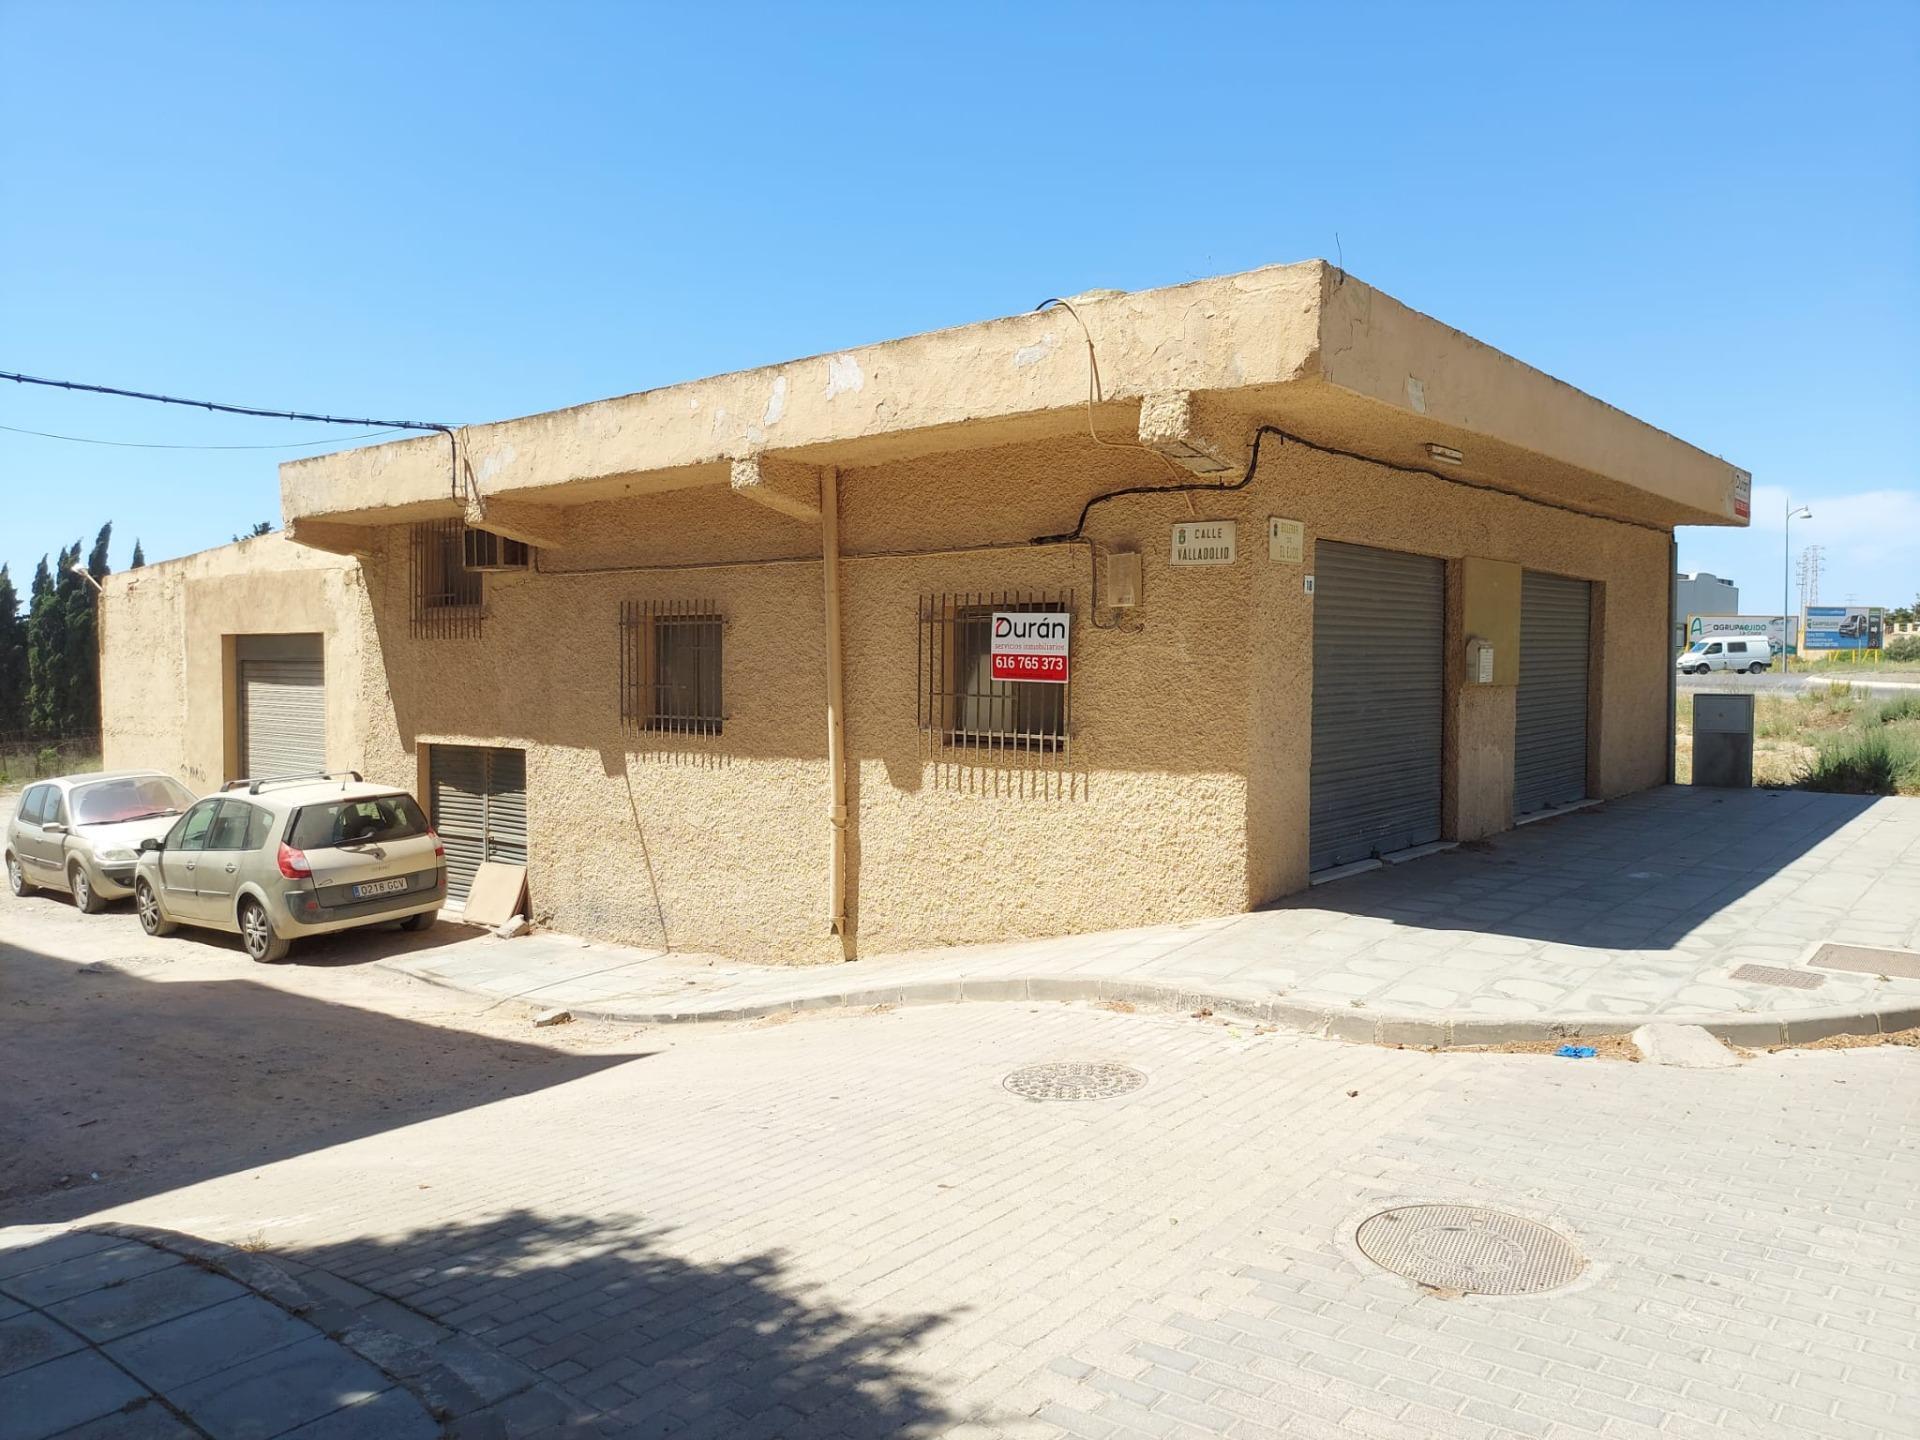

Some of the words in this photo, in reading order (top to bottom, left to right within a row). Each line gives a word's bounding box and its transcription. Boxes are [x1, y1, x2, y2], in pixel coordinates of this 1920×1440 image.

[1194, 528, 1223, 539] CALLE
[1177, 546, 1230, 560] VALLADOLID
[995, 617, 1065, 639] Durán
[995, 656, 1015, 668] 616
[1018, 657, 1039, 670] 765
[1041, 657, 1063, 670] 373
[361, 884, 385, 895] 0218
[387, 879, 404, 890] GCV
